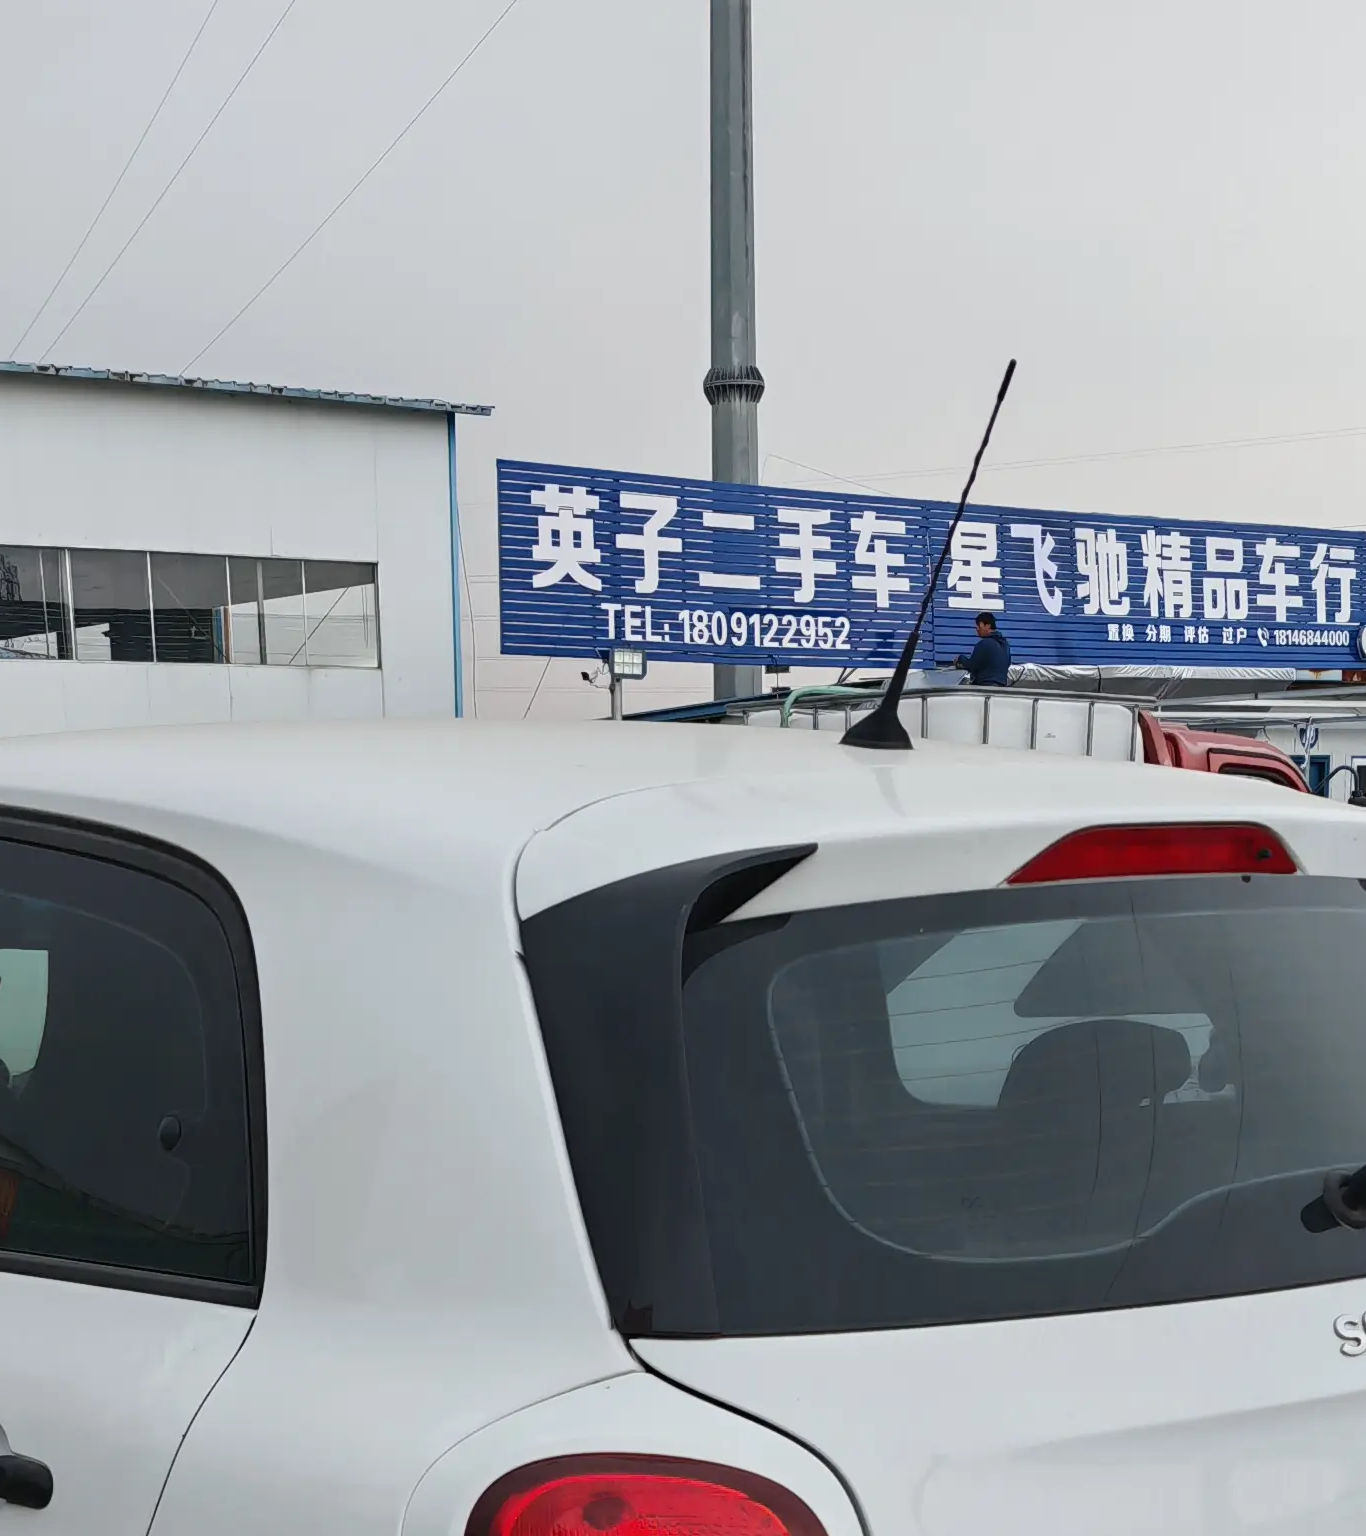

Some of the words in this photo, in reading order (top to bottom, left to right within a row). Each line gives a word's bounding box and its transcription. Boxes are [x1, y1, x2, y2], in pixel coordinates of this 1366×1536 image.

[530, 483, 910, 609] 英子二手车
[946, 520, 1357, 625] 星飞驰精品车行
[600, 602, 670, 642] TEL:
[678, 608, 851, 650] 1809122952
[1107, 623, 1135, 642] 置换
[1145, 624, 1172, 643] 分期
[1183, 625, 1209, 644] 评估
[1222, 626, 1247, 645] 过户
[1273, 629, 1350, 647] 18146844000
